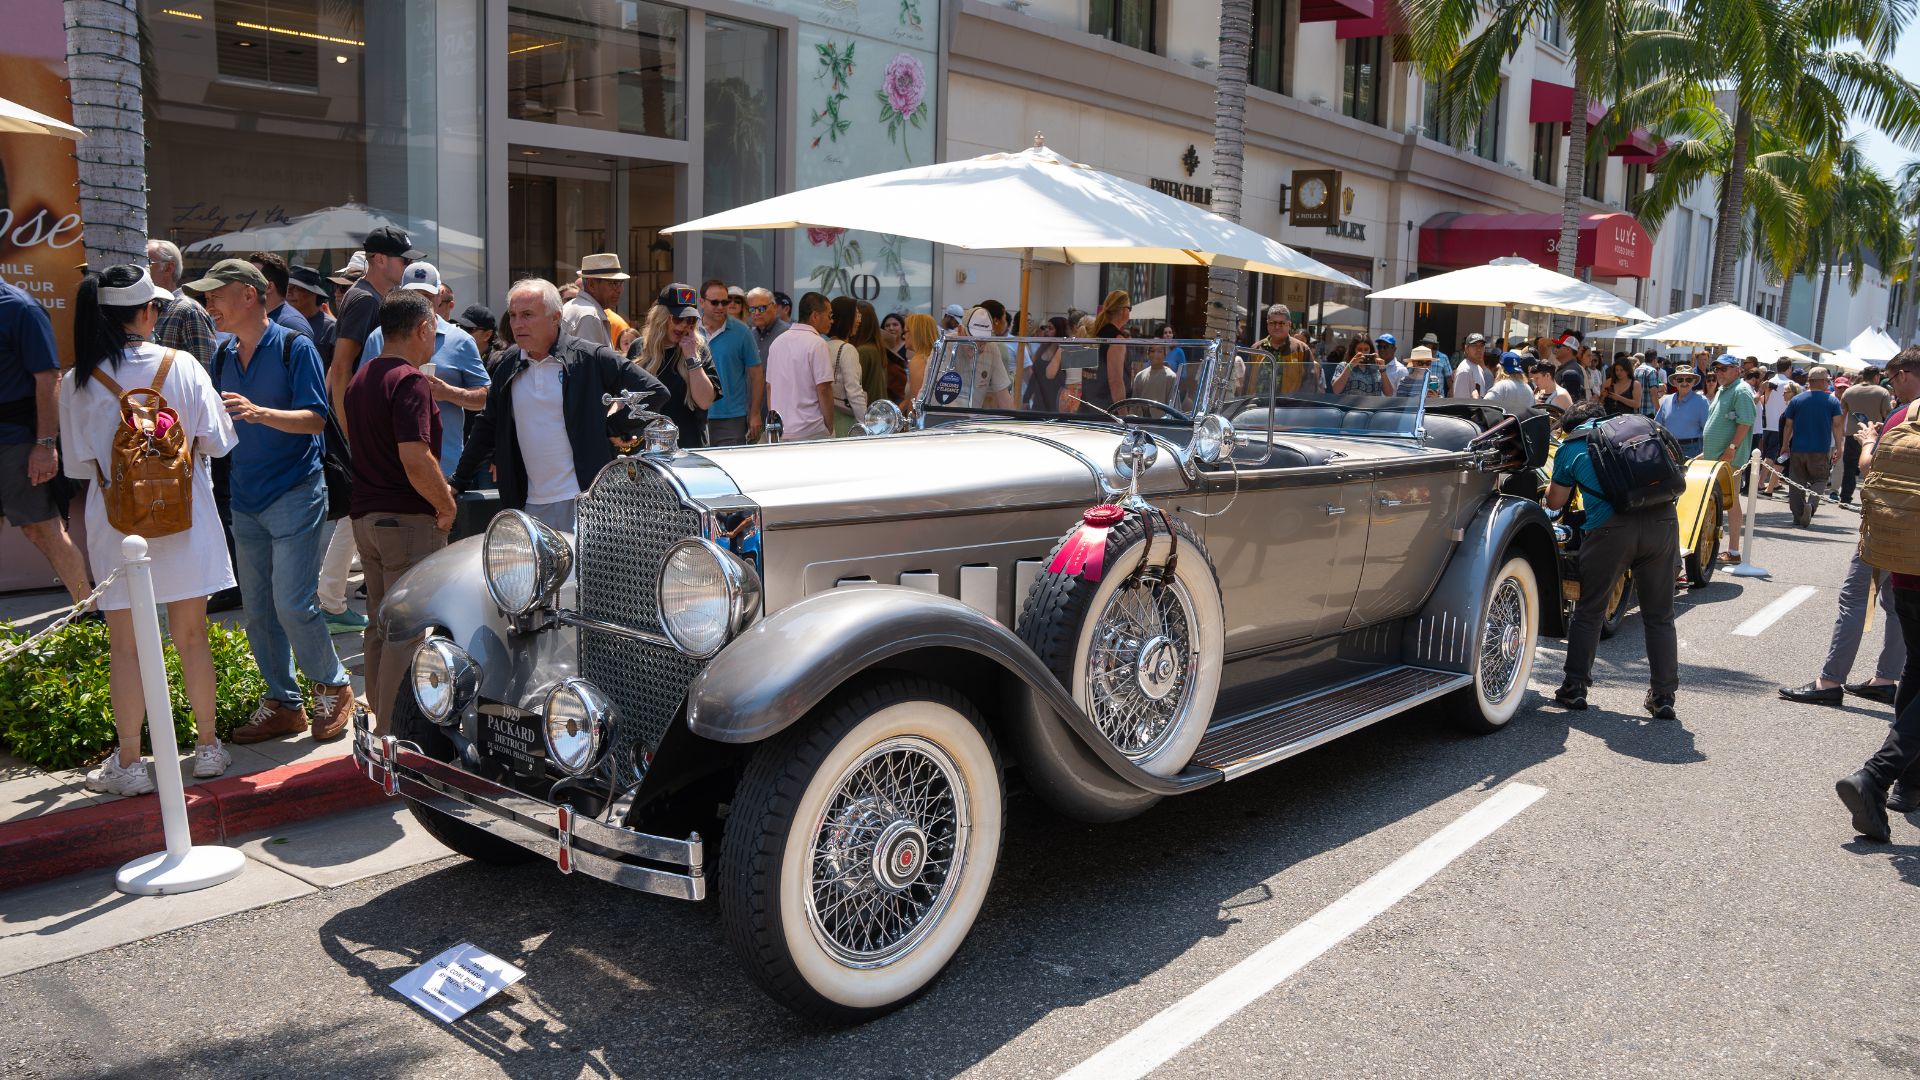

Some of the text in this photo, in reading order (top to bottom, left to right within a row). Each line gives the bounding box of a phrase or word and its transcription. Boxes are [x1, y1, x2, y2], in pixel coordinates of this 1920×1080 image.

[236, 209, 258, 232] of
[264, 204, 293, 225] the
[1615, 226, 1637, 246] LUXE
[503, 706, 520, 722] 1929
[488, 715, 535, 743] PACKARD
[495, 733, 527, 753] DIETRICH
[459, 963, 482, 978] PACKARD
